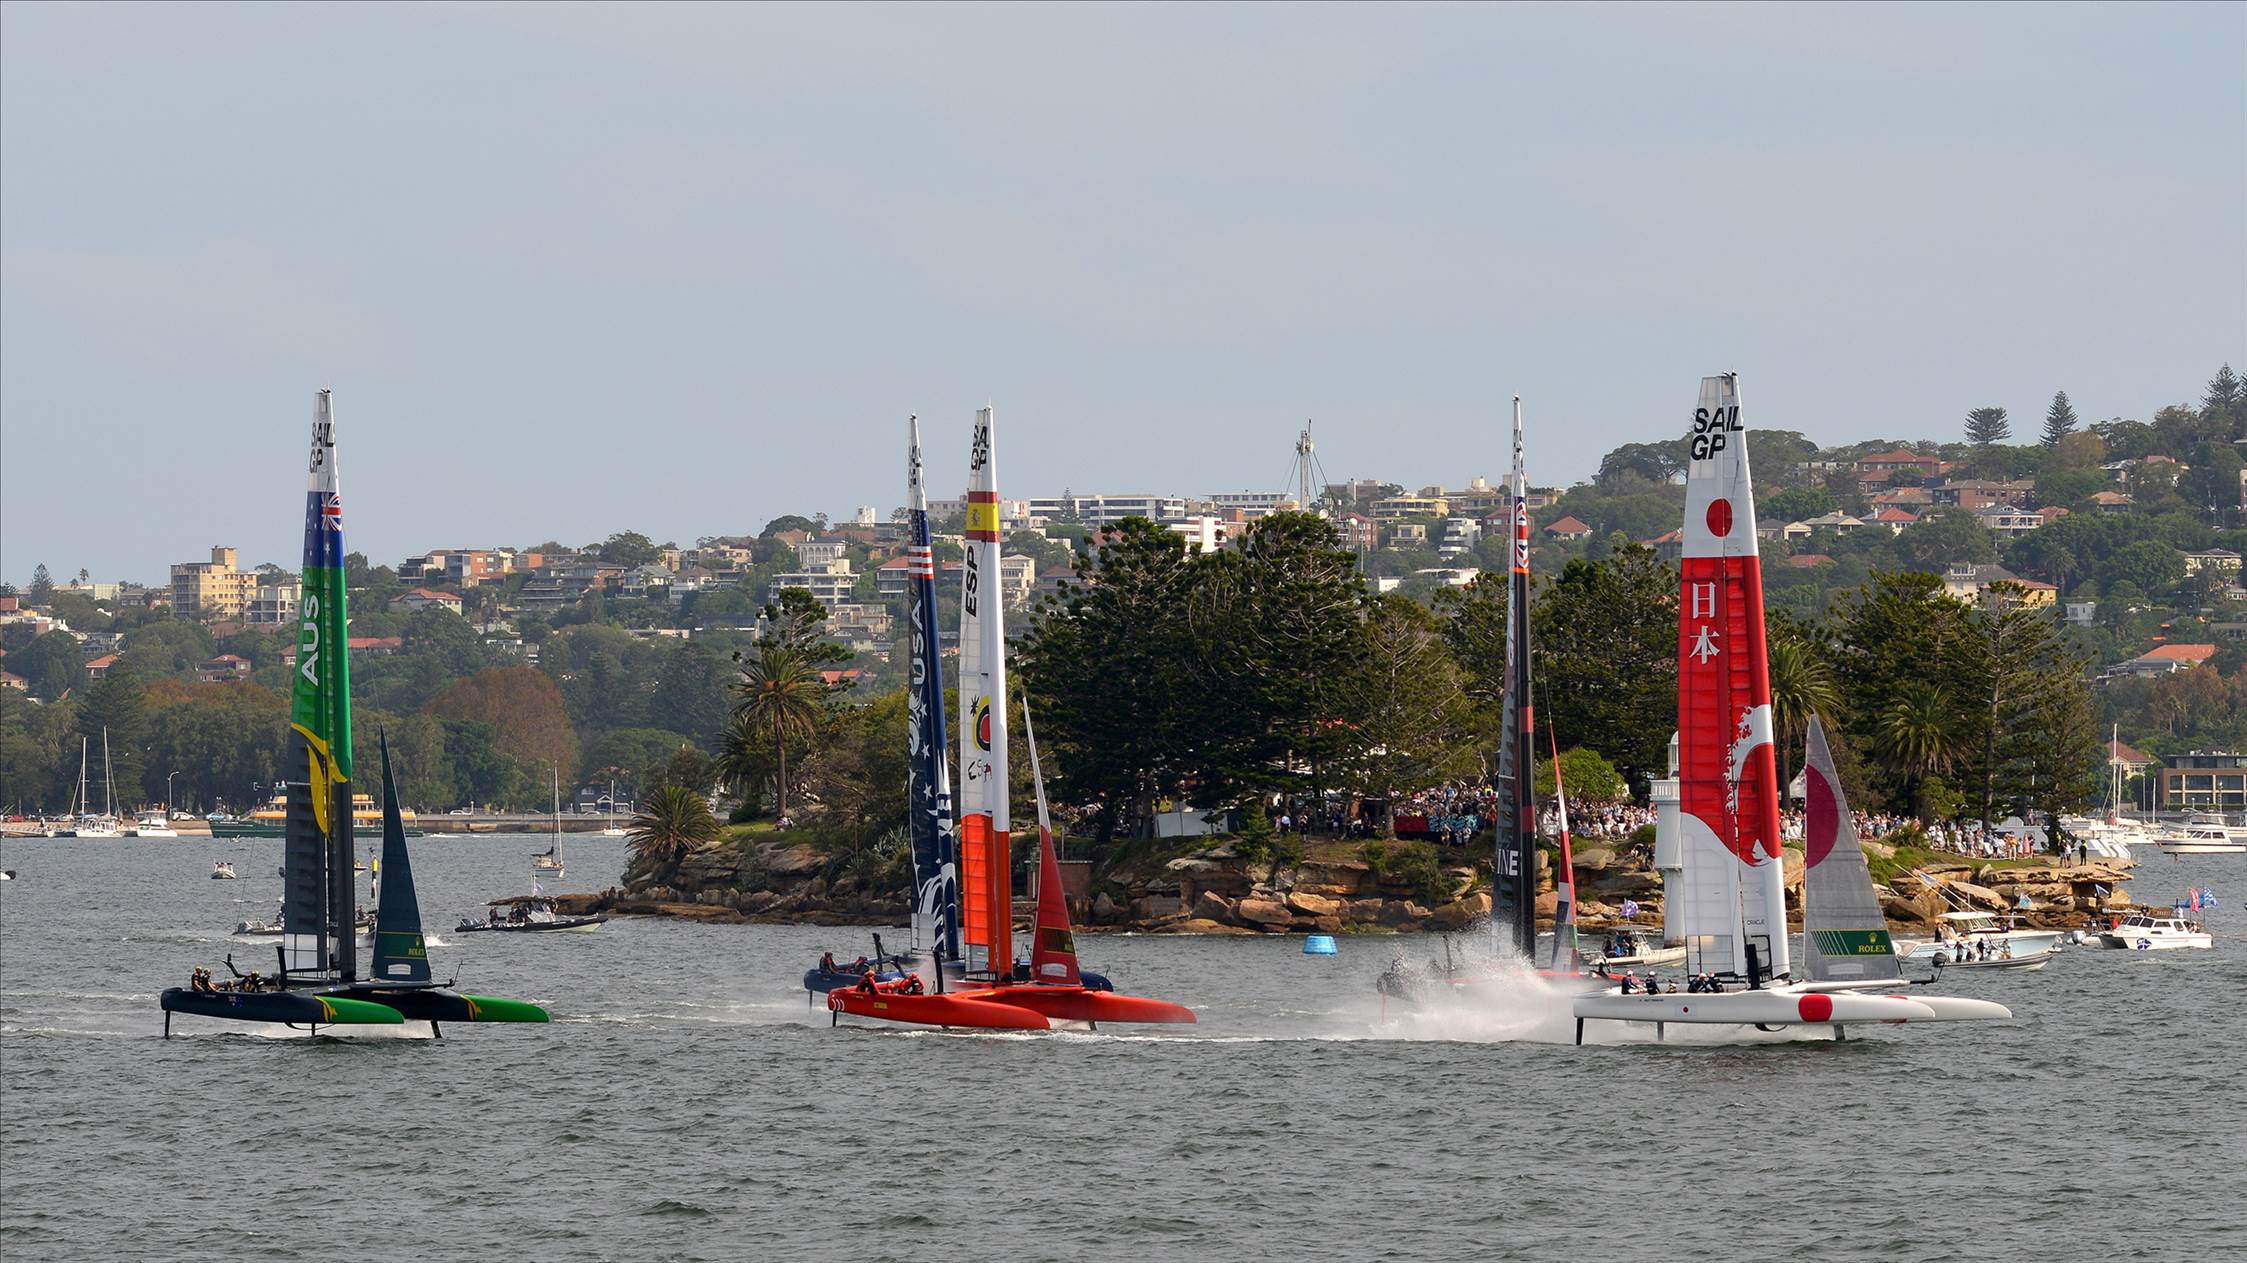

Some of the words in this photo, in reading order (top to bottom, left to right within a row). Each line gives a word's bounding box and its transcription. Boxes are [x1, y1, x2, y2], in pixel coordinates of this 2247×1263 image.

[1693, 406, 1744, 434] SAIL
[311, 422, 334, 448] SAIL
[1690, 434, 1726, 461] GP
[309, 448, 324, 473] GP
[970, 448, 987, 471] GP
[965, 545, 980, 618] ESP
[1689, 581, 1721, 666] 日本
[301, 594, 320, 687] AUS
[911, 599, 926, 685] USA
[1858, 944, 1887, 953] ROLEX
